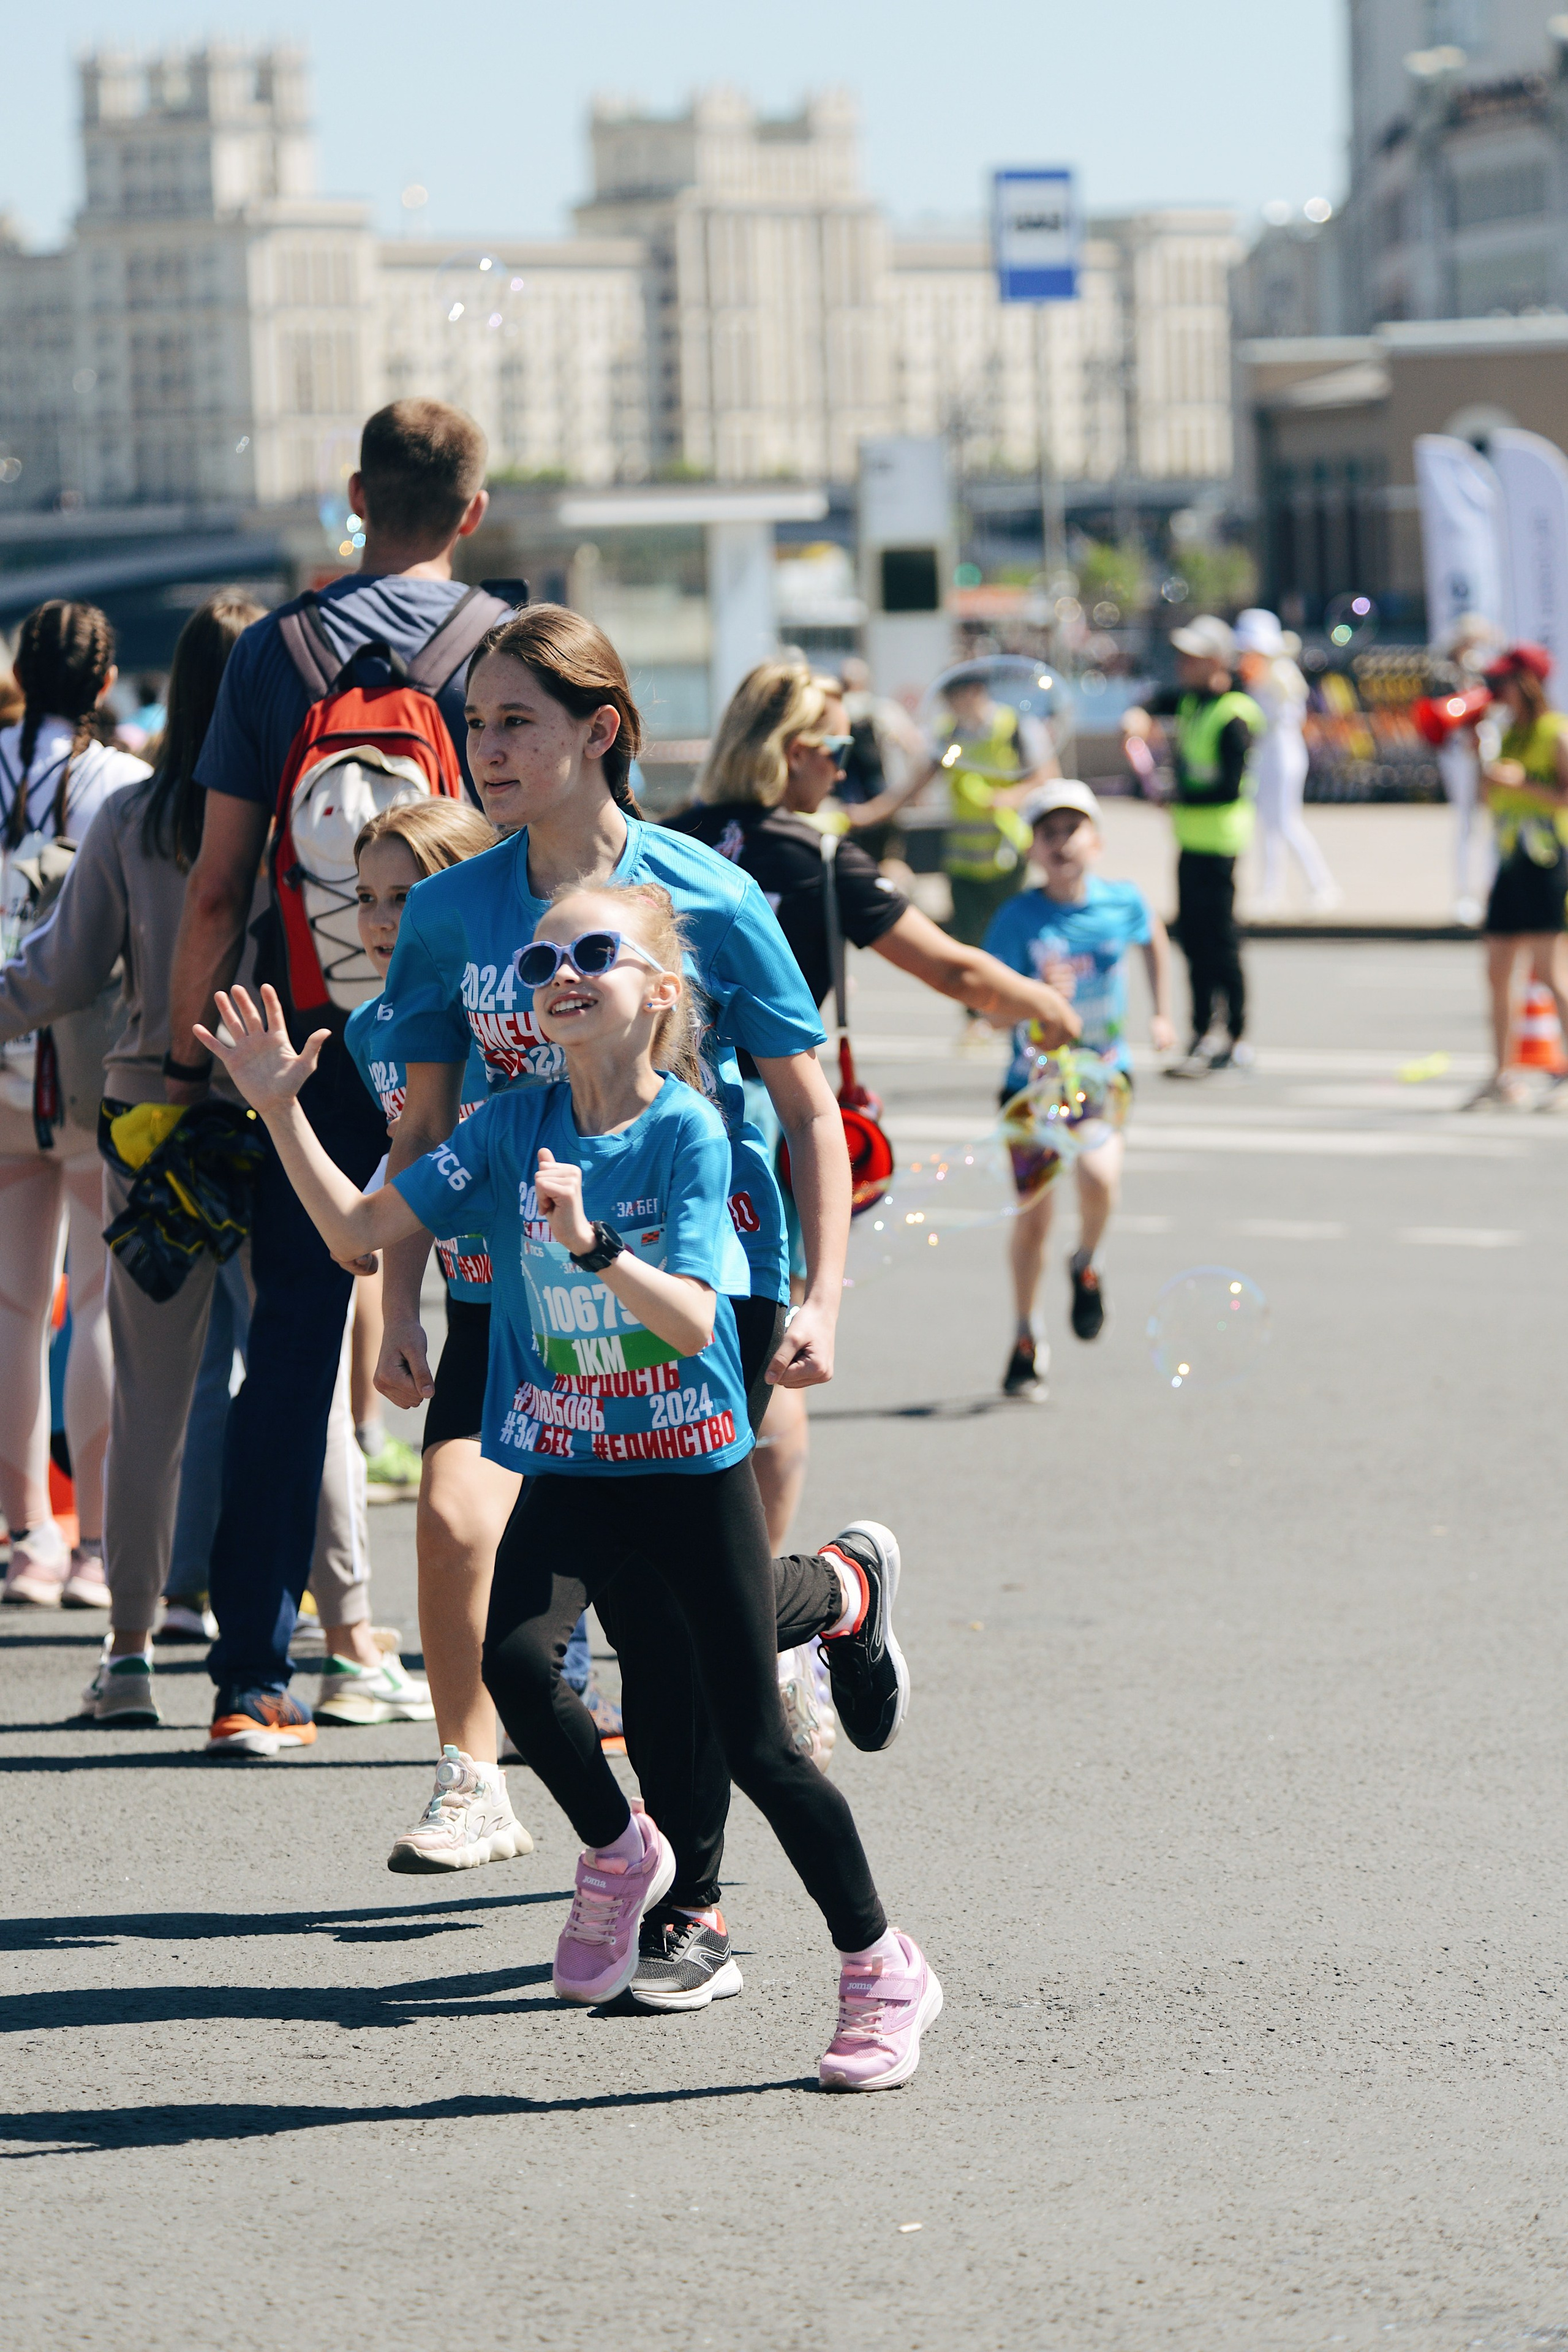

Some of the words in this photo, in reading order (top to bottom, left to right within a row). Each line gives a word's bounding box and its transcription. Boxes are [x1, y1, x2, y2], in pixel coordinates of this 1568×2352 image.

[460, 962, 517, 1011] 2024
[467, 1011, 550, 1052] #МЕЧ
[650, 1382, 714, 1429] 2024
[592, 1410, 737, 1461] #ЕДИНСТВО
